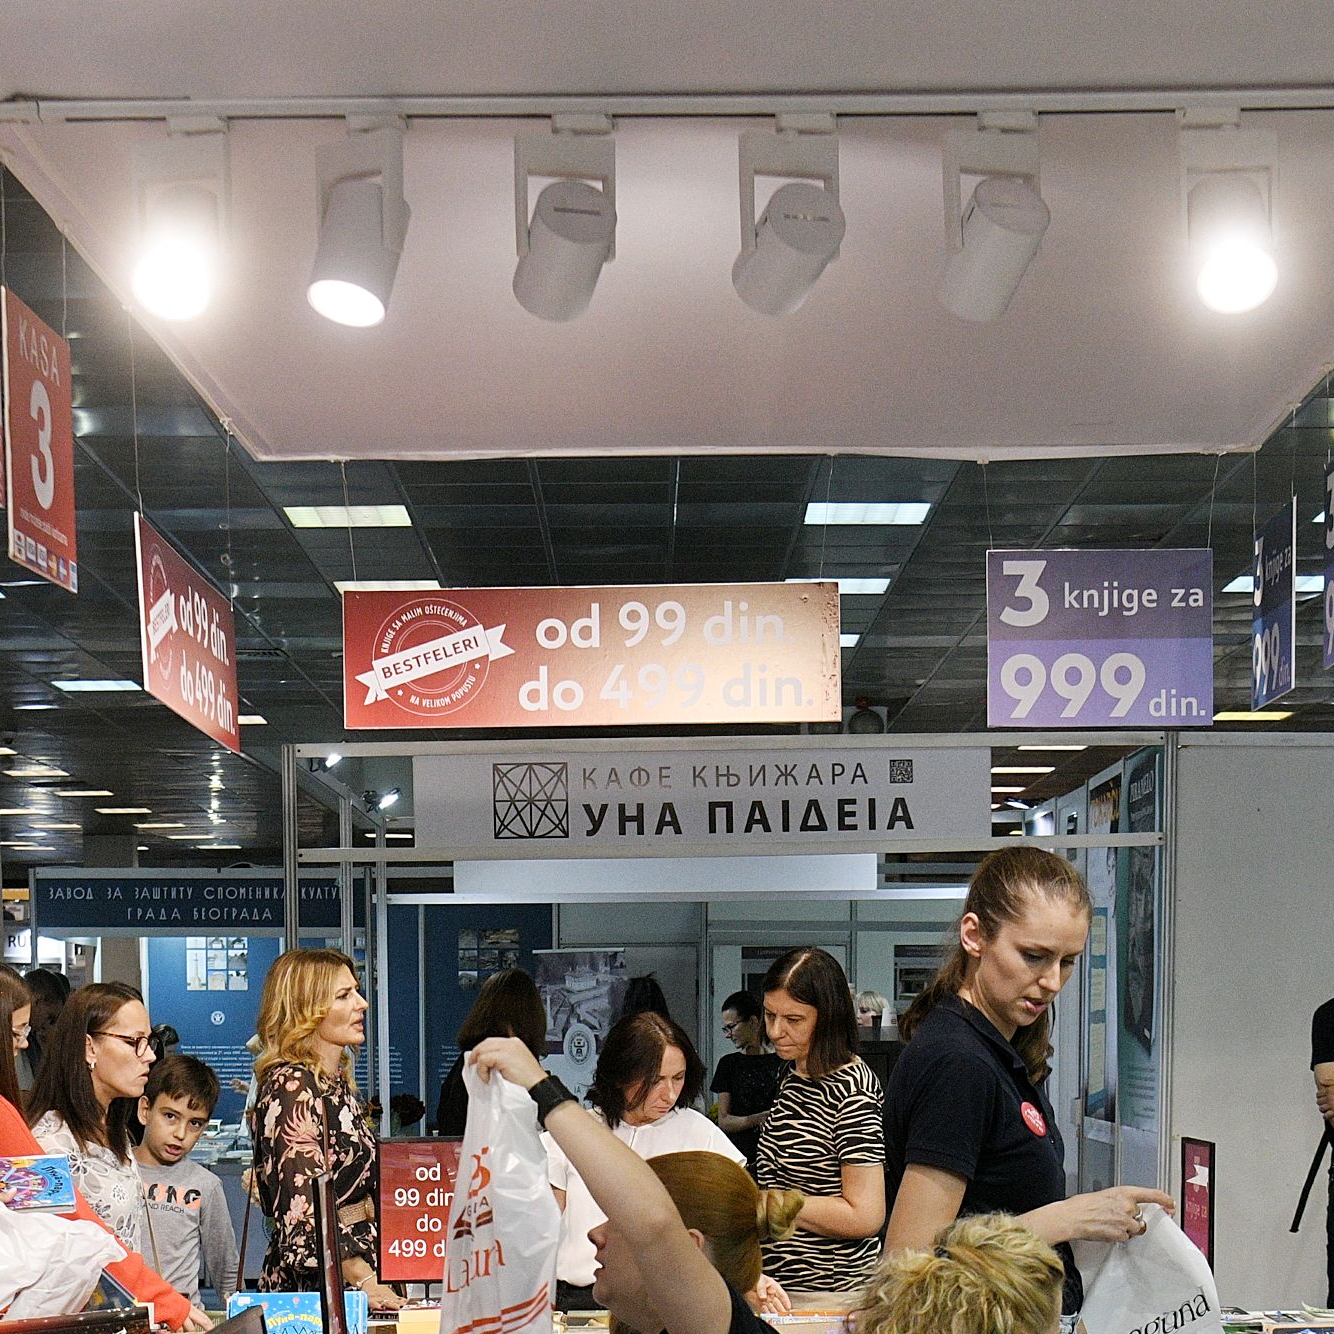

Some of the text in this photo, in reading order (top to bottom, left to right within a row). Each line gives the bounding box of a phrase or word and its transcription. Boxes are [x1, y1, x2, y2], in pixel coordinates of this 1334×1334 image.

[18, 318, 59, 388] KASA
[28, 380, 55, 510] 3
[1000, 560, 1206, 627] 3 knjige za
[1253, 536, 1264, 606] 3
[179, 585, 230, 668] od 99 din.
[380, 630, 400, 654] KNJIGE
[401, 606, 425, 625] MALIM
[535, 600, 797, 649] od 99 din.
[381, 637, 480, 679] BESTFELERI
[1253, 623, 1280, 700] 999
[179, 662, 236, 736] do 499 din.
[421, 692, 452, 707] VELIKOM
[450, 674, 478, 704] POPUSTU
[518, 663, 815, 712] do 499 din.
[1000, 652, 1207, 720] 999 din.
[581, 761, 870, 790] КАФЕ КЊИЖАРА
[583, 802, 682, 838] УНА
[49, 886, 94, 900] ЗАВОД
[106, 886, 123, 900] ЗА
[133, 886, 194, 900] ЗАШТИТУ
[126, 906, 273, 922] ГРАДА БЕОГРАДА
[415, 1163, 442, 1182] od
[160, 1203, 185, 1215] REACH
[393, 1189, 421, 1208] 99
[415, 1213, 442, 1233] do
[388, 1239, 428, 1258] 499
